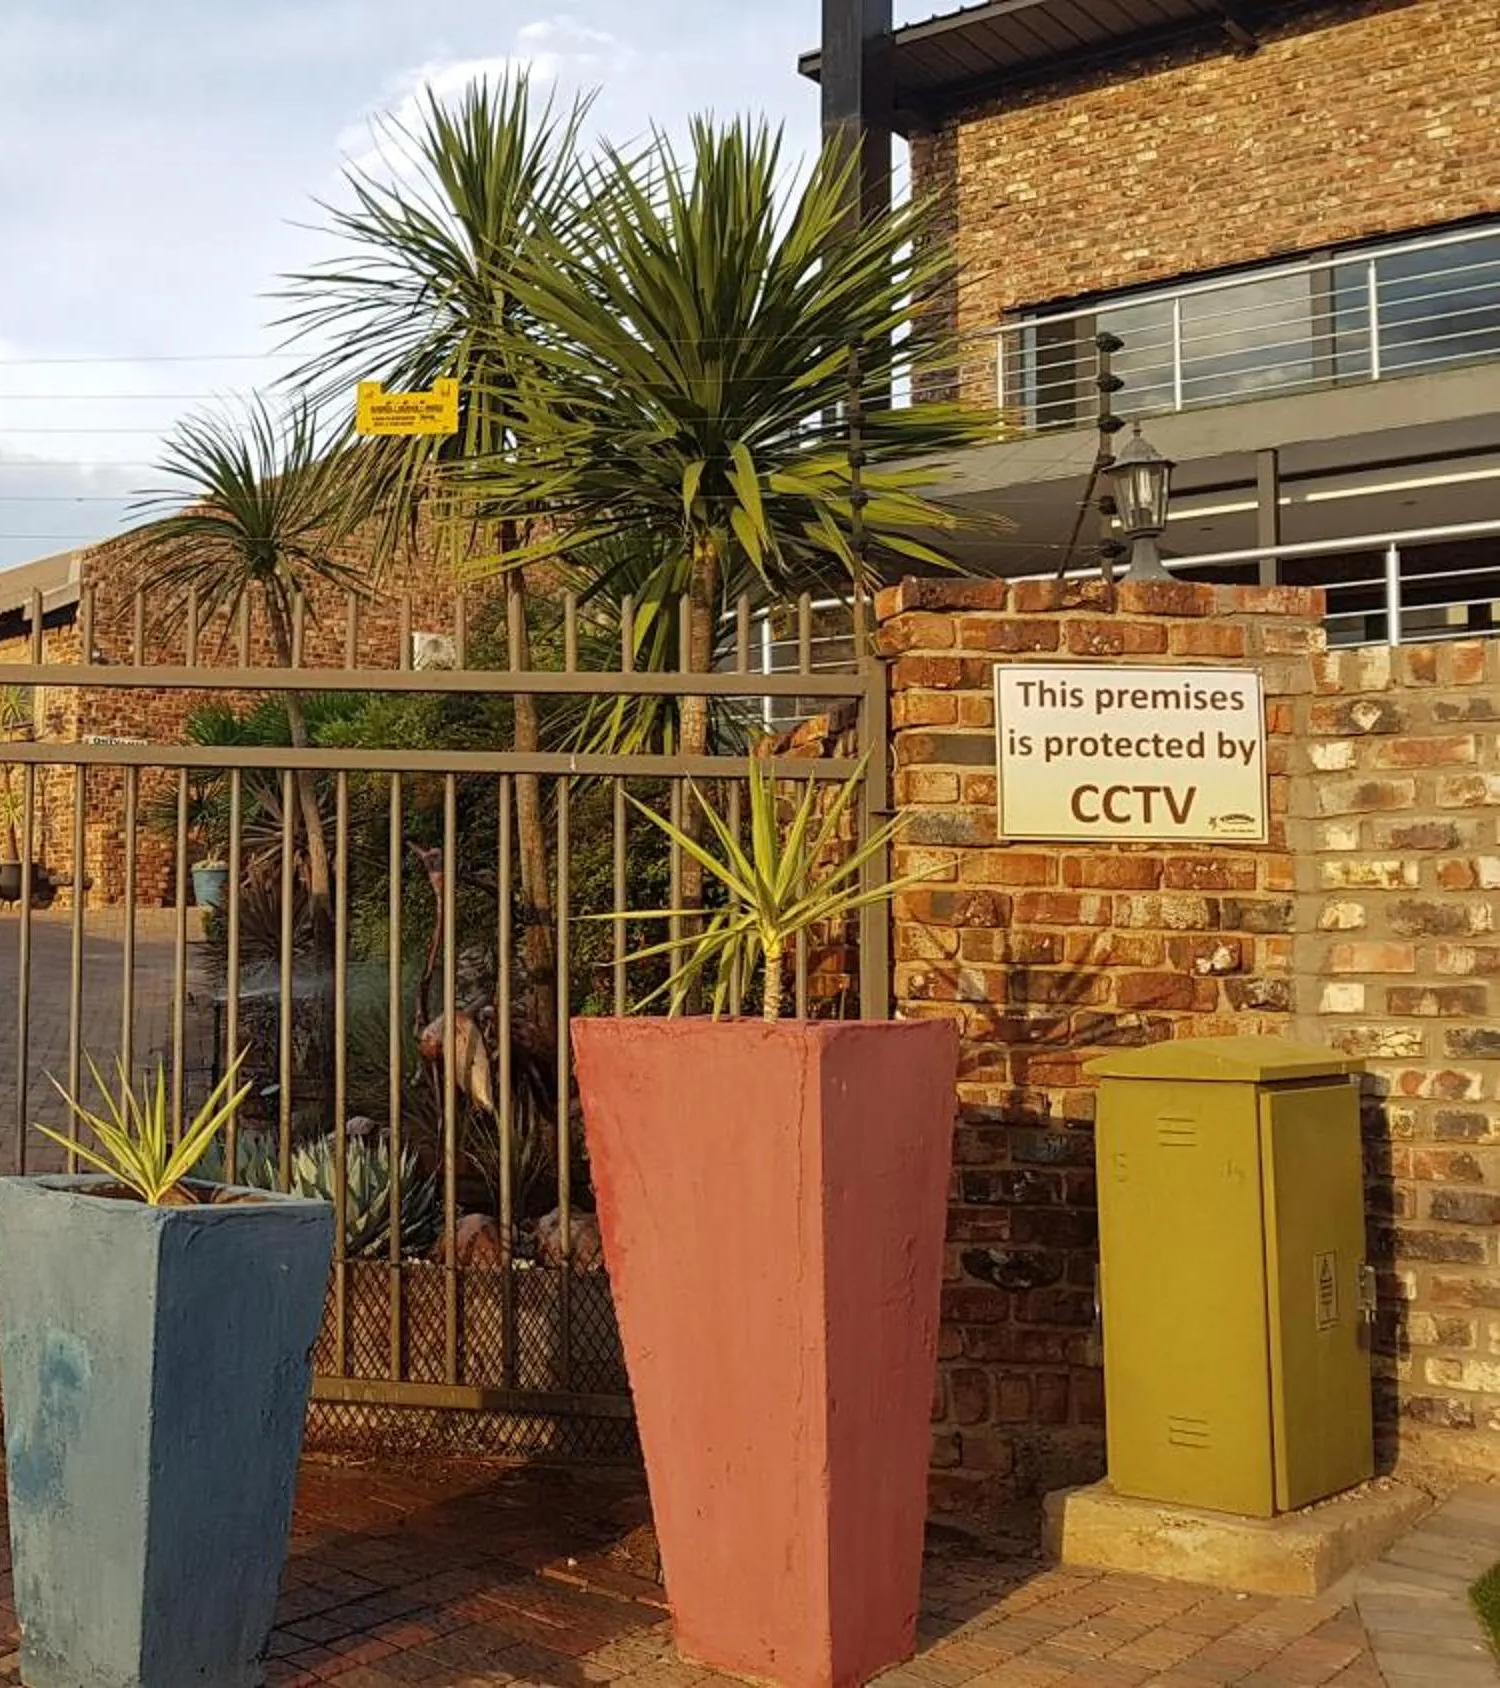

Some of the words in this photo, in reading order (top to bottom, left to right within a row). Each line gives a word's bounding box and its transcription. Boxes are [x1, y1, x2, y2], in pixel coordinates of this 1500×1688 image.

[1016, 680, 1085, 709] This
[1095, 683, 1245, 715] premises
[1009, 729, 1033, 757] is
[1045, 731, 1205, 763] protected
[1217, 731, 1256, 766] by
[1071, 784, 1197, 825] CCTV
